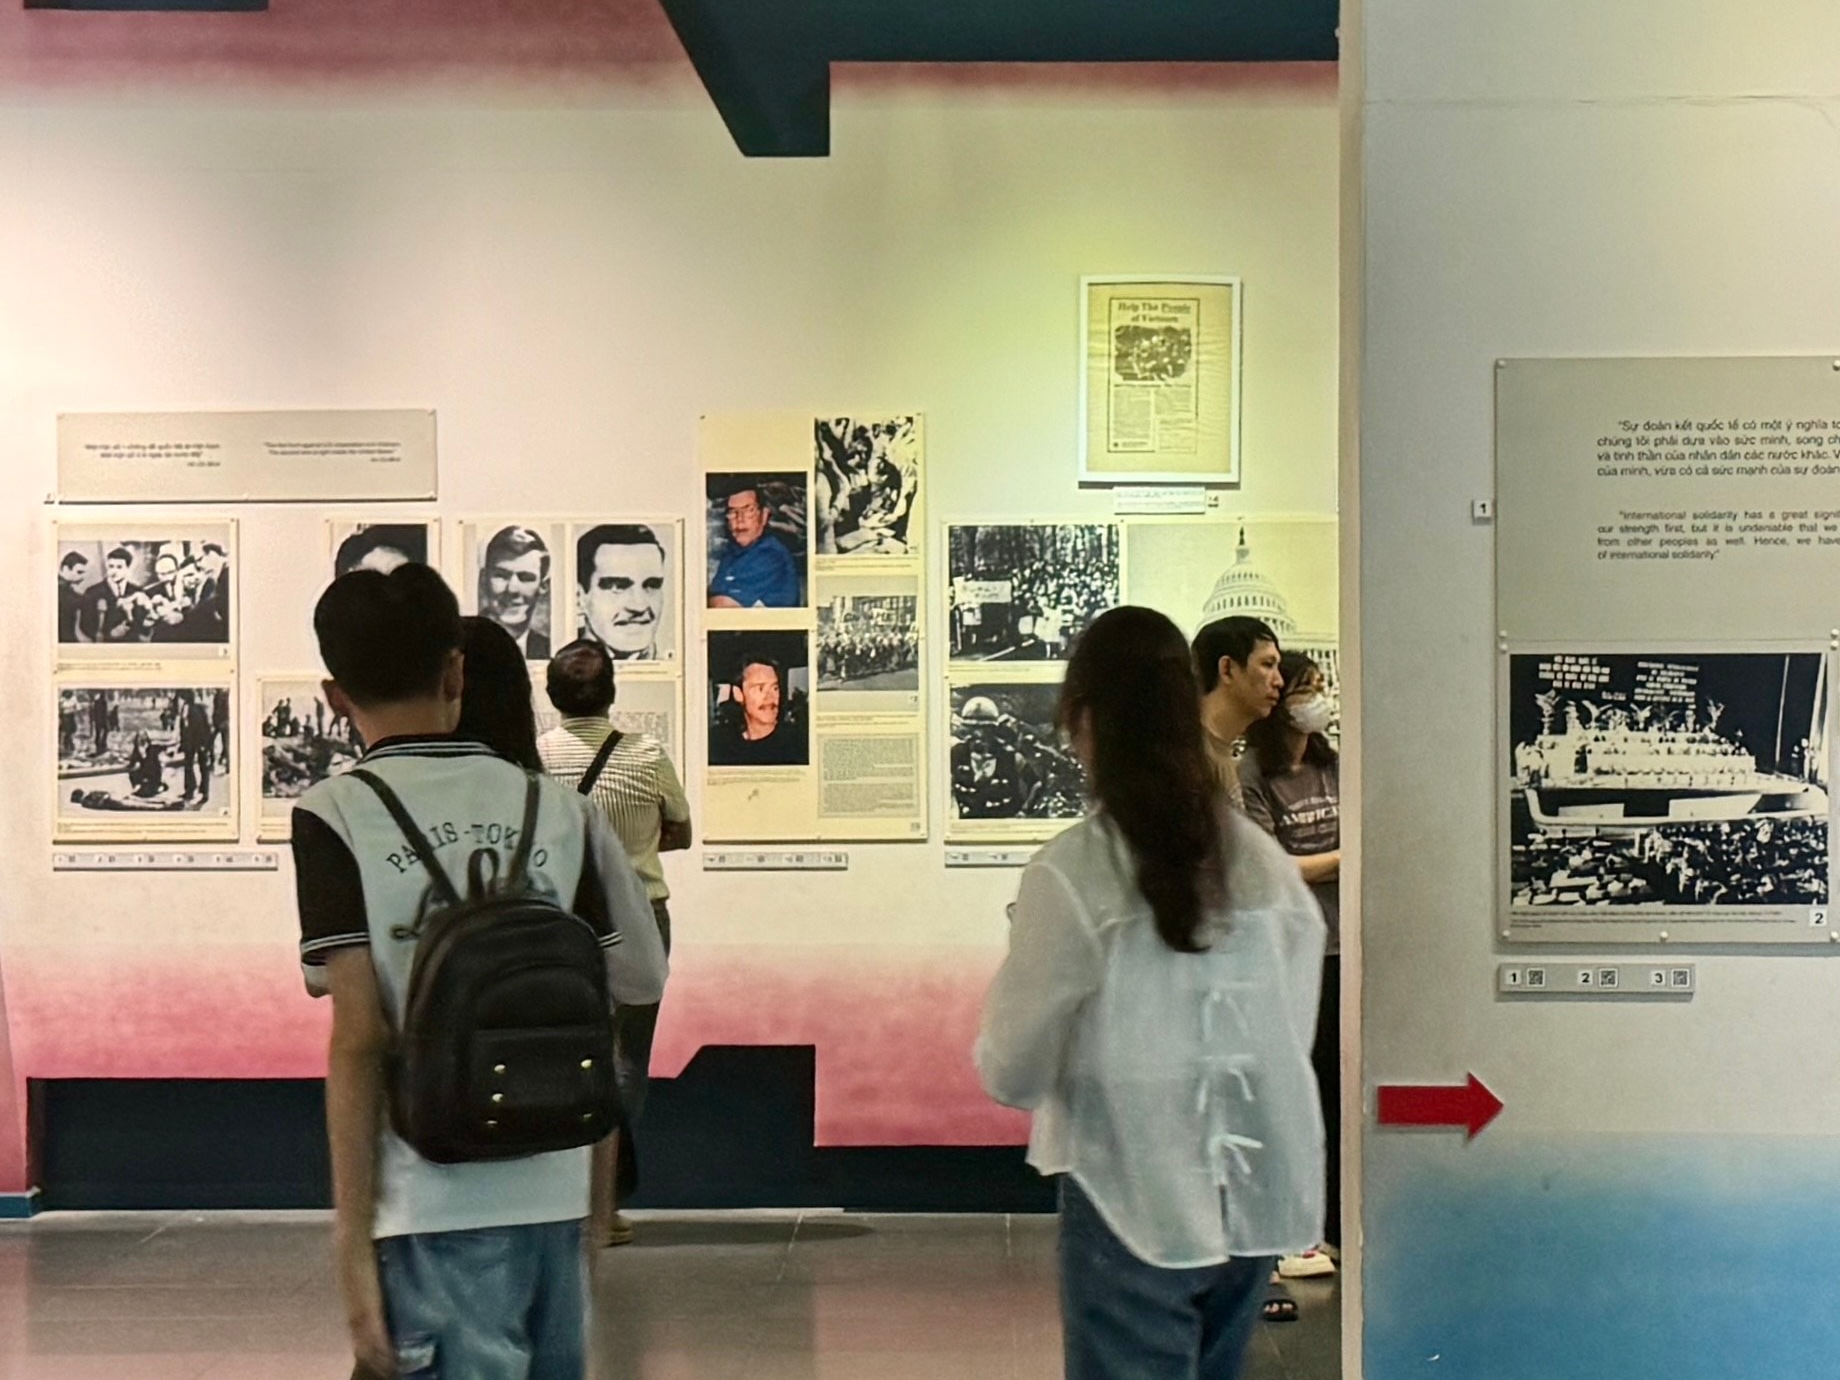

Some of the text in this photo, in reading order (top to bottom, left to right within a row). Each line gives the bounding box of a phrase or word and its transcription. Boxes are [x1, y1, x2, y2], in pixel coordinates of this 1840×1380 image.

[1142, 302, 1158, 312] The
[1480, 503, 1487, 514] 1
[1815, 913, 1824, 924] 2
[1511, 972, 1663, 983] 1 2 3
